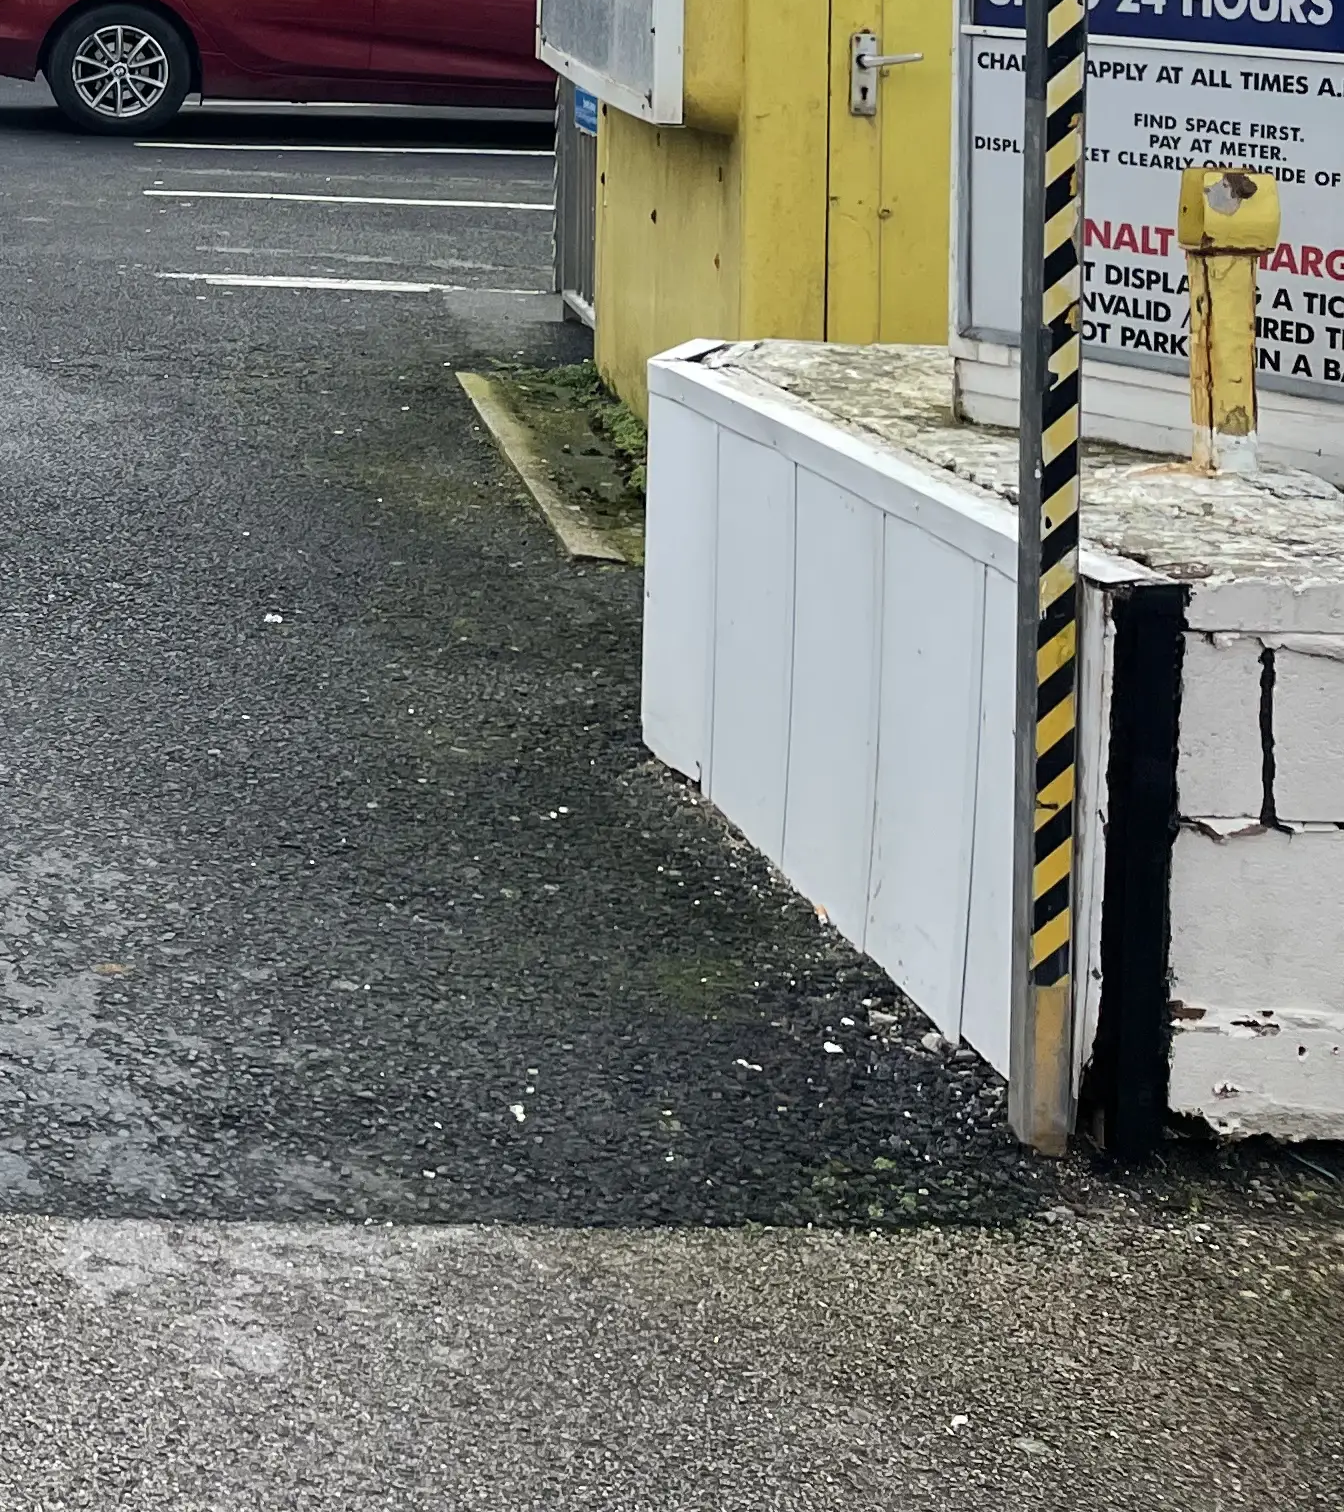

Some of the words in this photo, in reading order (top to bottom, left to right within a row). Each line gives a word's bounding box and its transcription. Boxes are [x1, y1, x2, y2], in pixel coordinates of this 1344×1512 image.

[1085, 60, 1148, 83] APPLY
[1156, 66, 1183, 85] AT
[1191, 68, 1232, 89] ALL
[1240, 71, 1308, 95] TIMES
[1317, 78, 1344, 99] A.
[1134, 113, 1177, 131] FIND
[1185, 117, 1241, 136] SPACE
[1250, 123, 1305, 143] FIRST.
[975, 136, 1024, 154] DISPL
[1118, 151, 1195, 171] CLEARLY
[1314, 171, 1342, 188] OF
[1149, 134, 1181, 150] PAY
[1190, 137, 1211, 153] AT
[1220, 141, 1287, 162] METER.
[1085, 219, 1176, 257] NALT
[1082, 292, 1172, 323] NVALID
[1255, 316, 1315, 345] IRED
[1272, 288, 1294, 312] A
[1303, 291, 1344, 320] TIC
[1120, 325, 1189, 358] PARK
[1291, 354, 1313, 378] A
